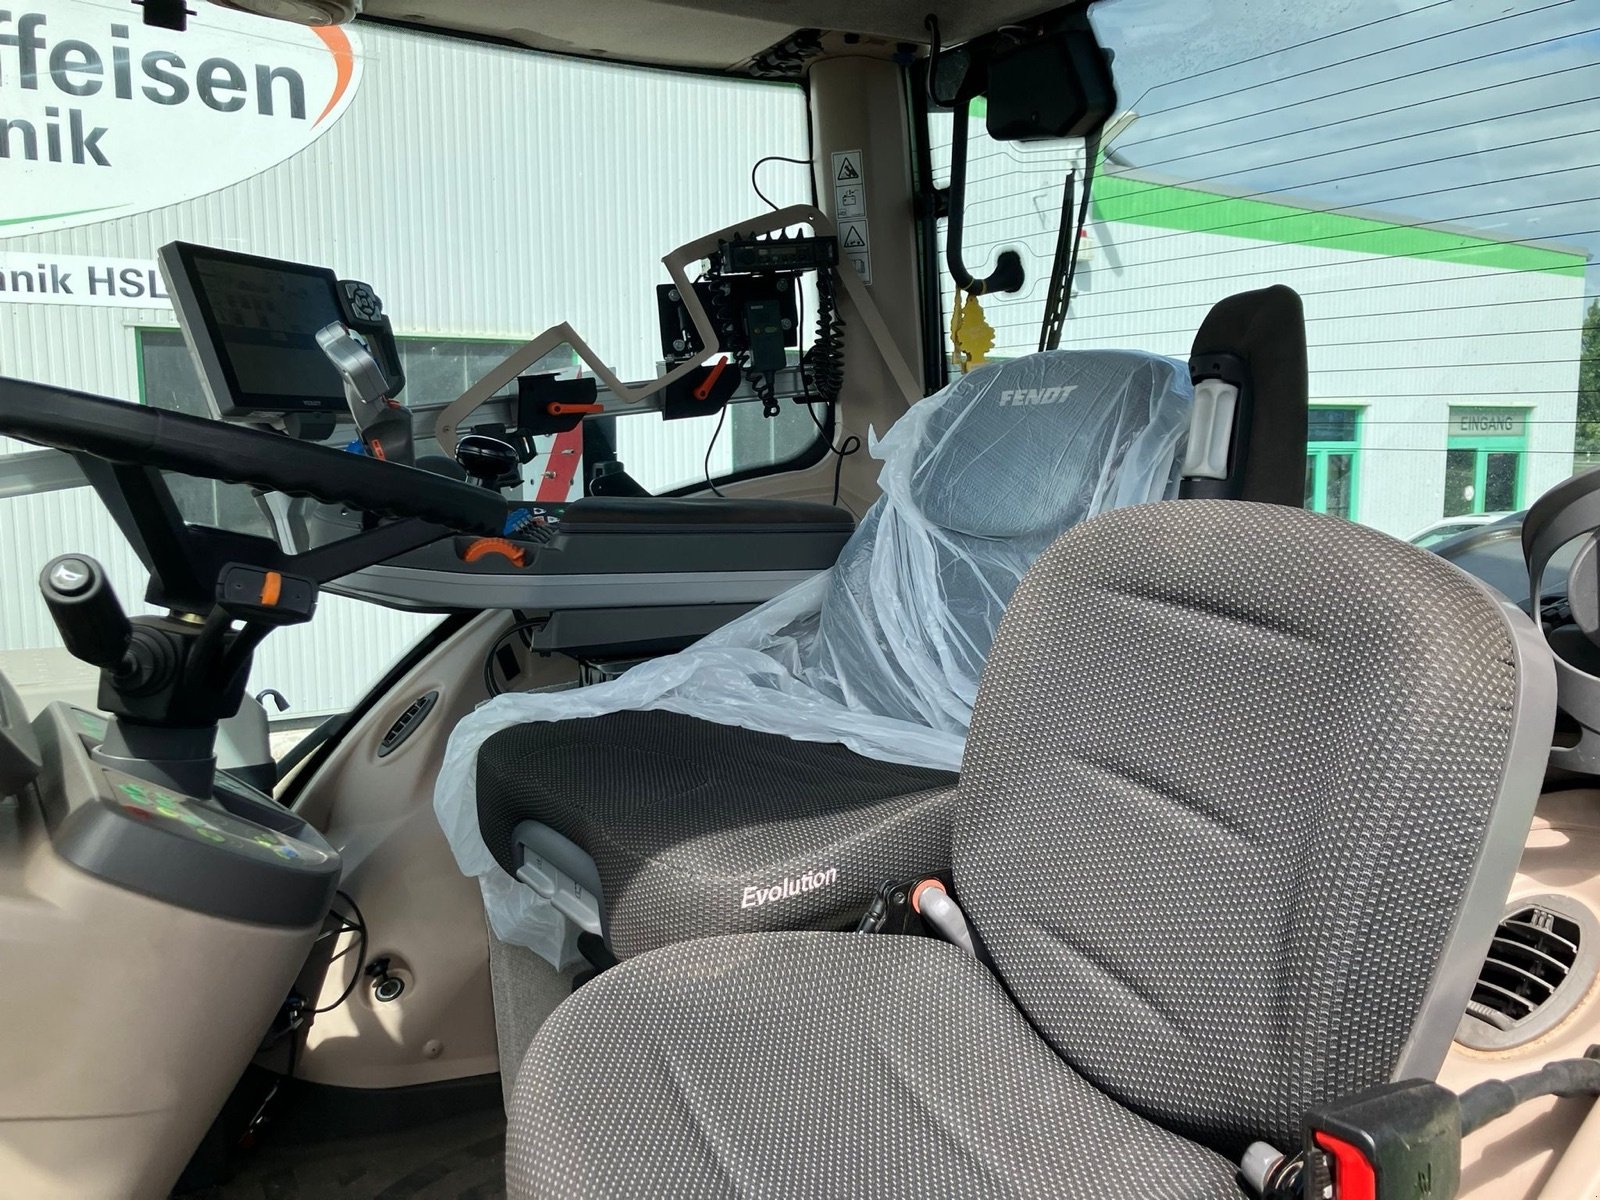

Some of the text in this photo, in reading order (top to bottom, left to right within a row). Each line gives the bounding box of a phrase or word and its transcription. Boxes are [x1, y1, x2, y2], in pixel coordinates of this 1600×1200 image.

[0, 263, 74, 295] nik
[998, 384, 1078, 407] FENDT
[1460, 415, 1513, 431] EINGANG
[740, 867, 838, 909] Evolution
